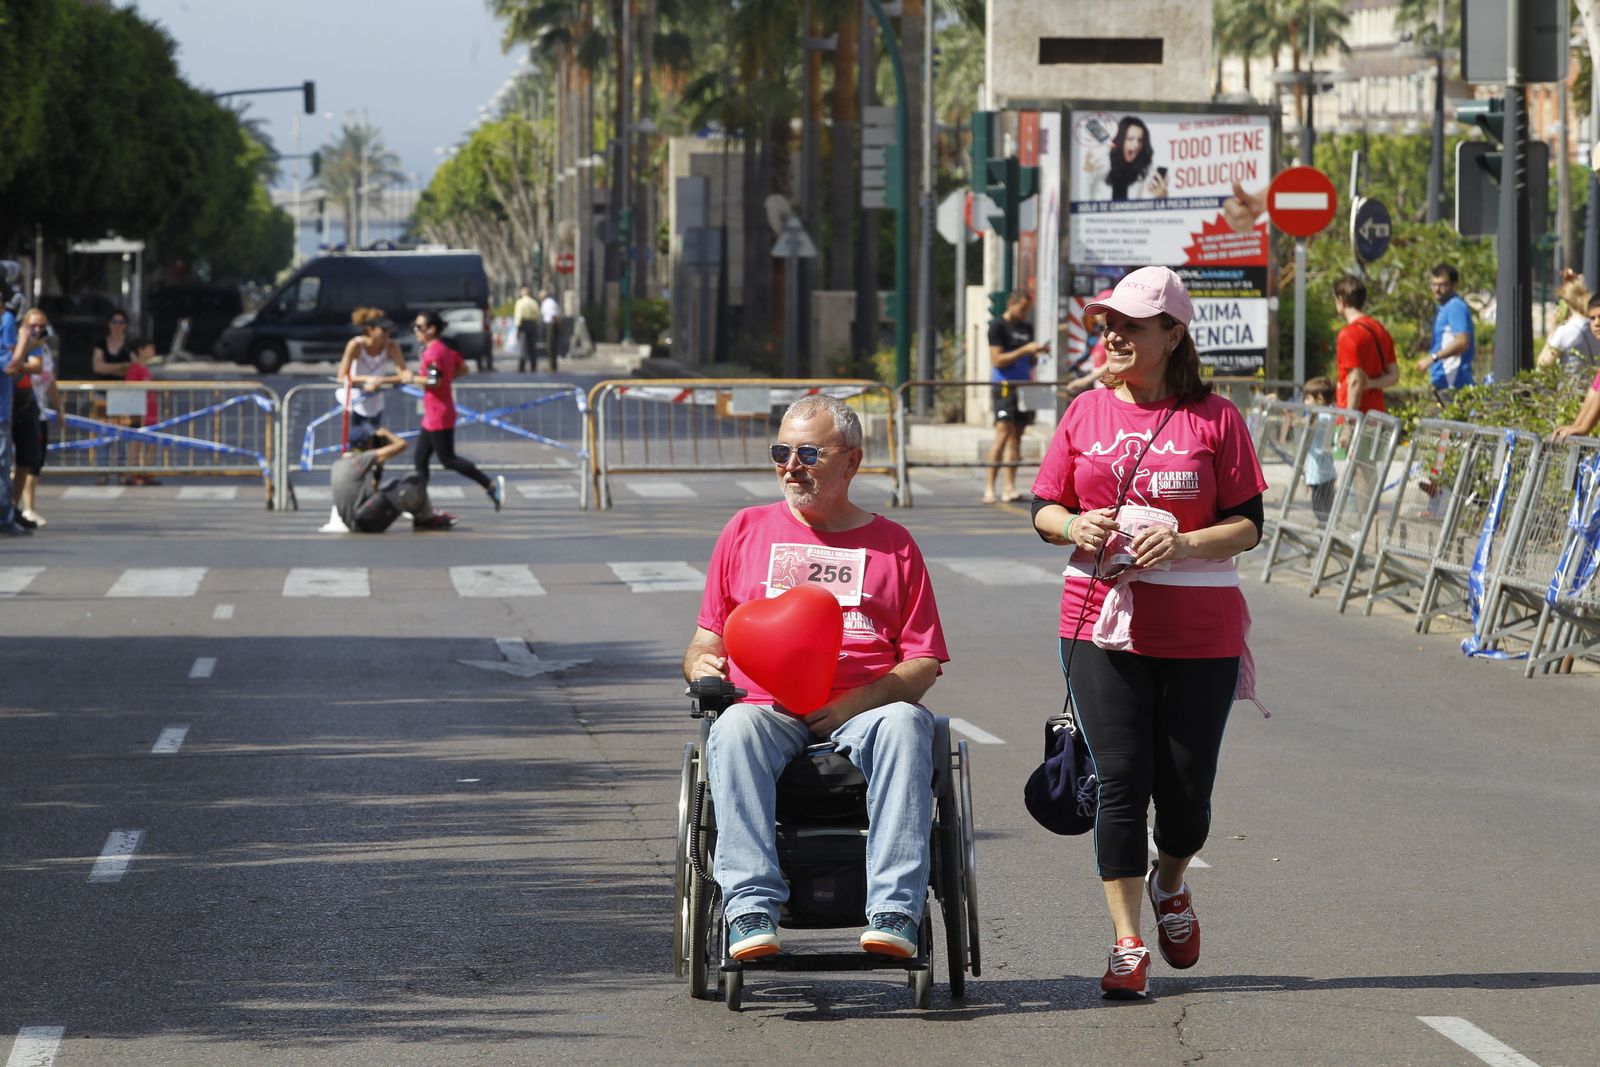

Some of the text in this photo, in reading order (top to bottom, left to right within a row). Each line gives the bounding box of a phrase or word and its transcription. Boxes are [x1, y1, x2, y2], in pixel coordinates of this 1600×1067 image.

[1168, 129, 1264, 162] TODO TIENE
[1147, 471, 1199, 498] 4 CARRERA
[1158, 480, 1199, 490] SOLIDARIA
[807, 563, 852, 583] 256
